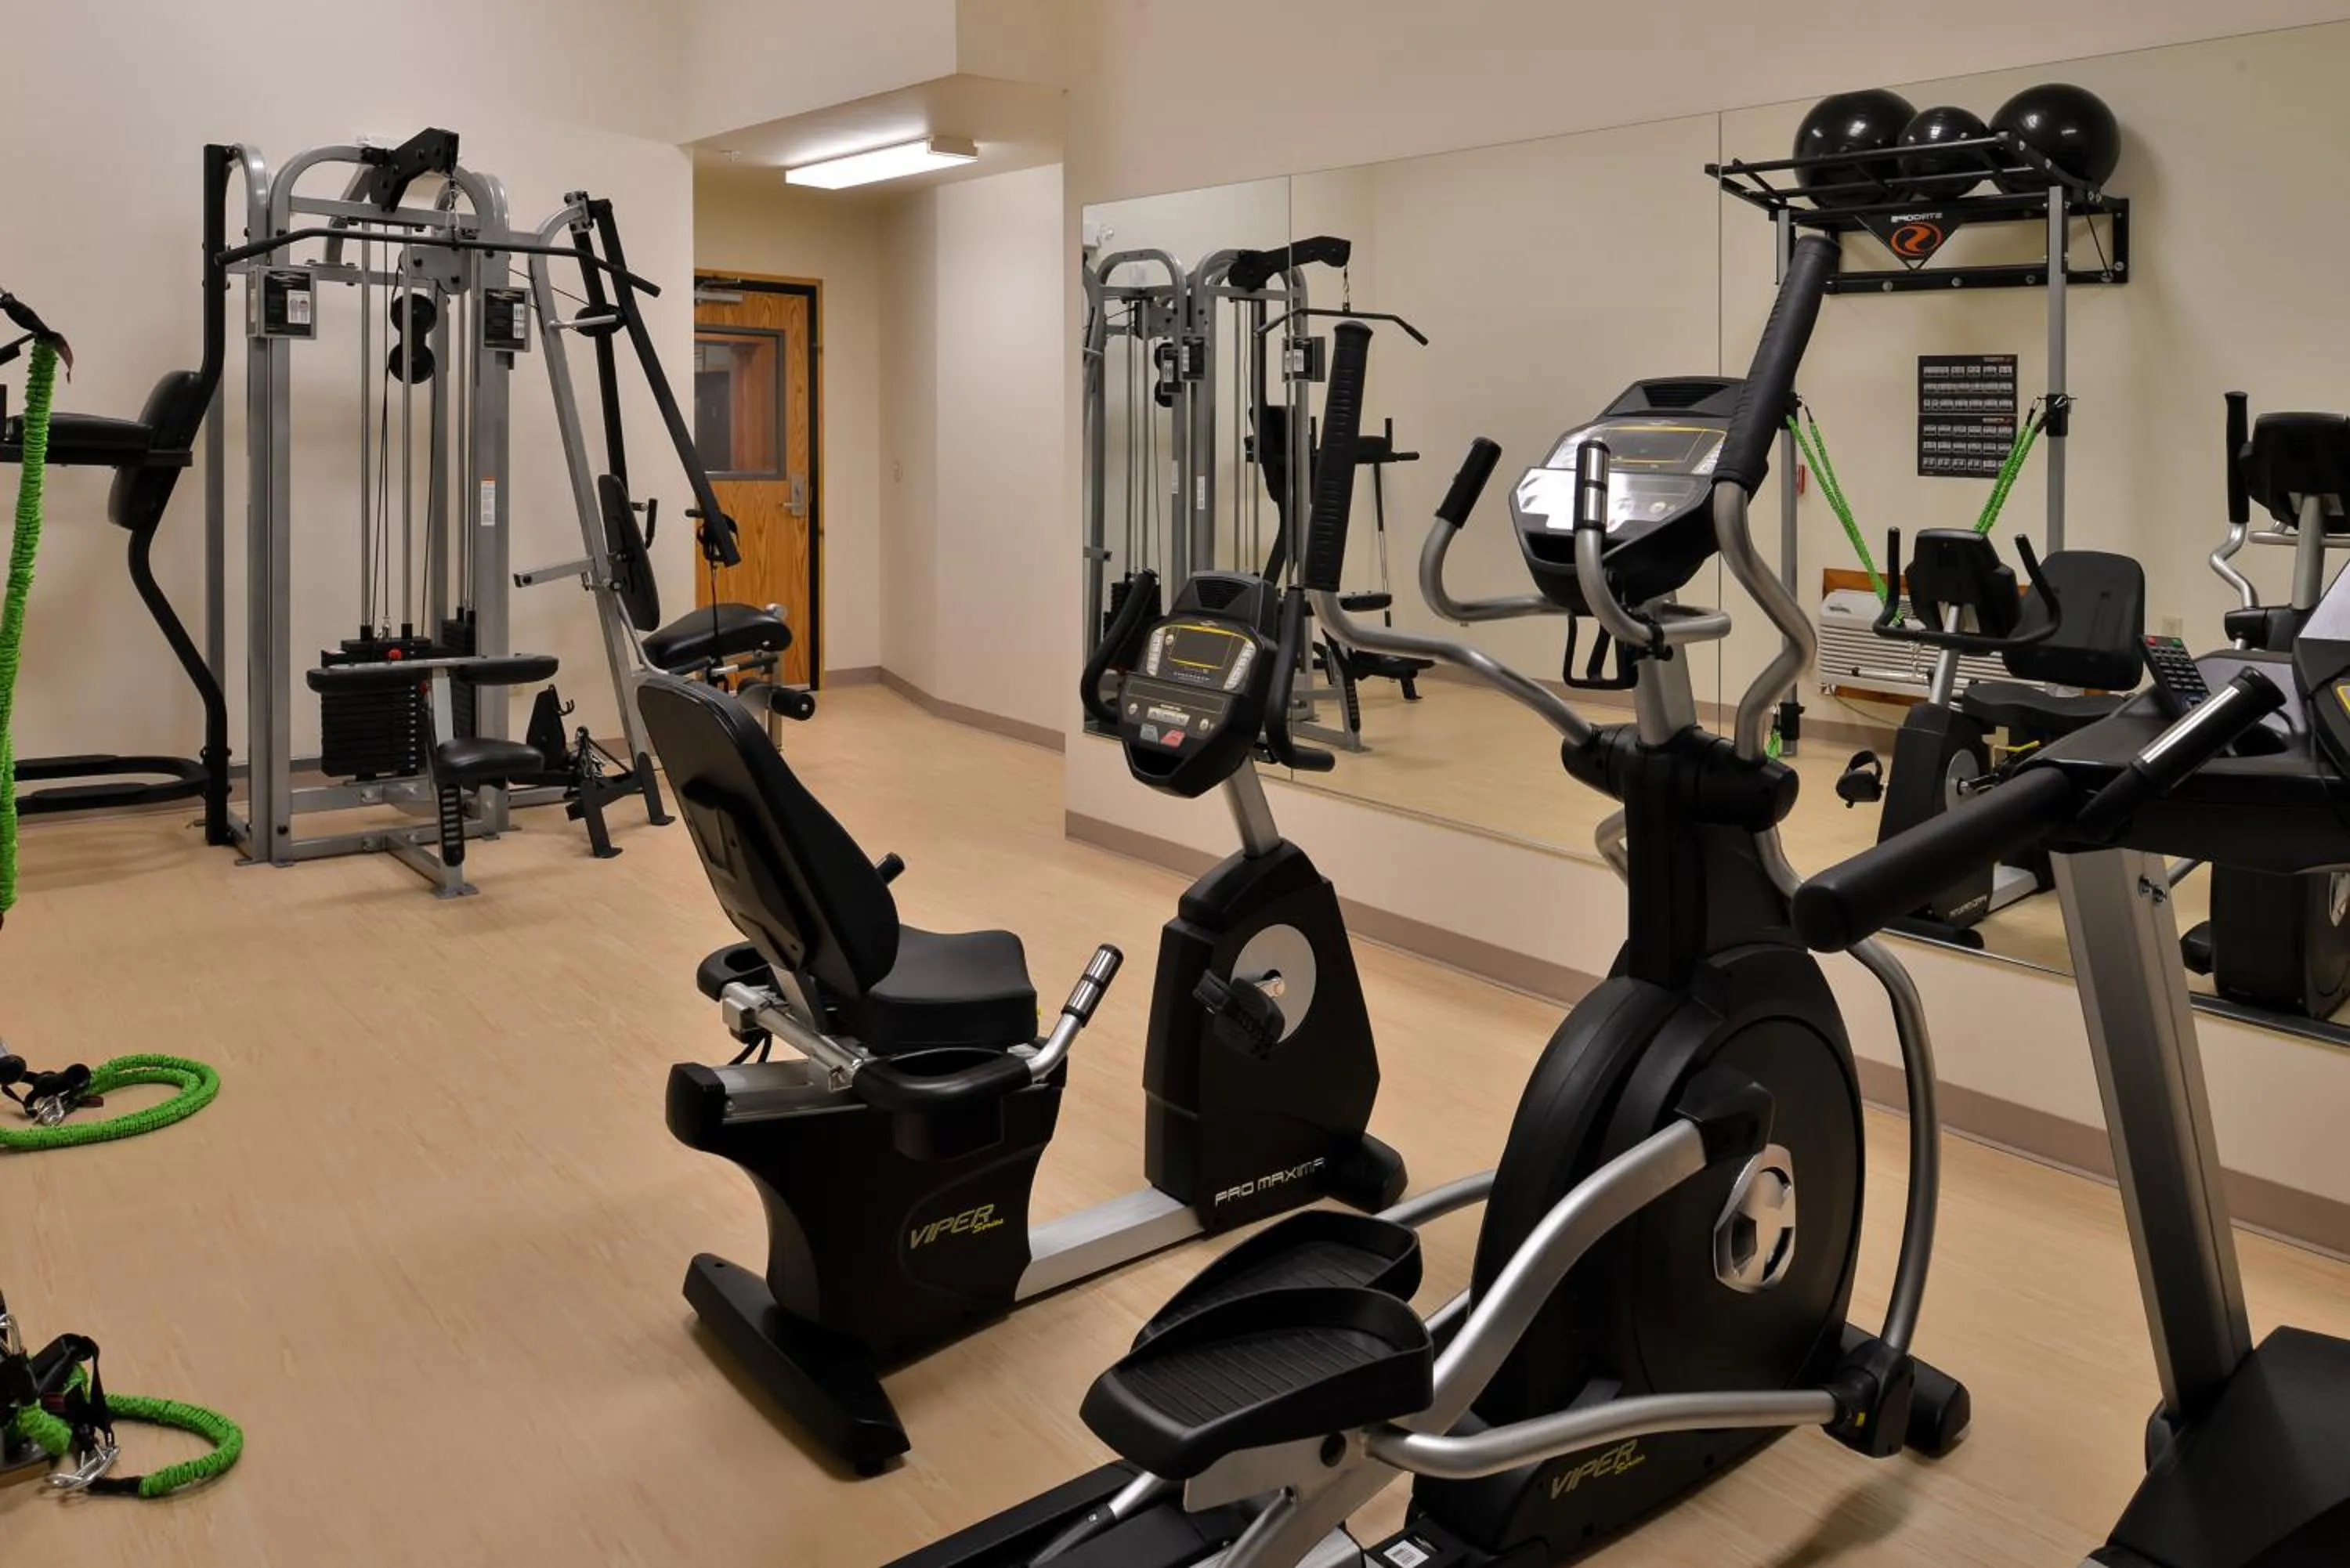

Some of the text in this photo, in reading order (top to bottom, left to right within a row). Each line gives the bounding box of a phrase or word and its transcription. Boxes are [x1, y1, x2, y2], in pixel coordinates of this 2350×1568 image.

[1215, 1157, 1325, 1207] PRO MAXIMA
[911, 1203, 994, 1249] VIPER
[1551, 1439, 1638, 1499] VIPER
